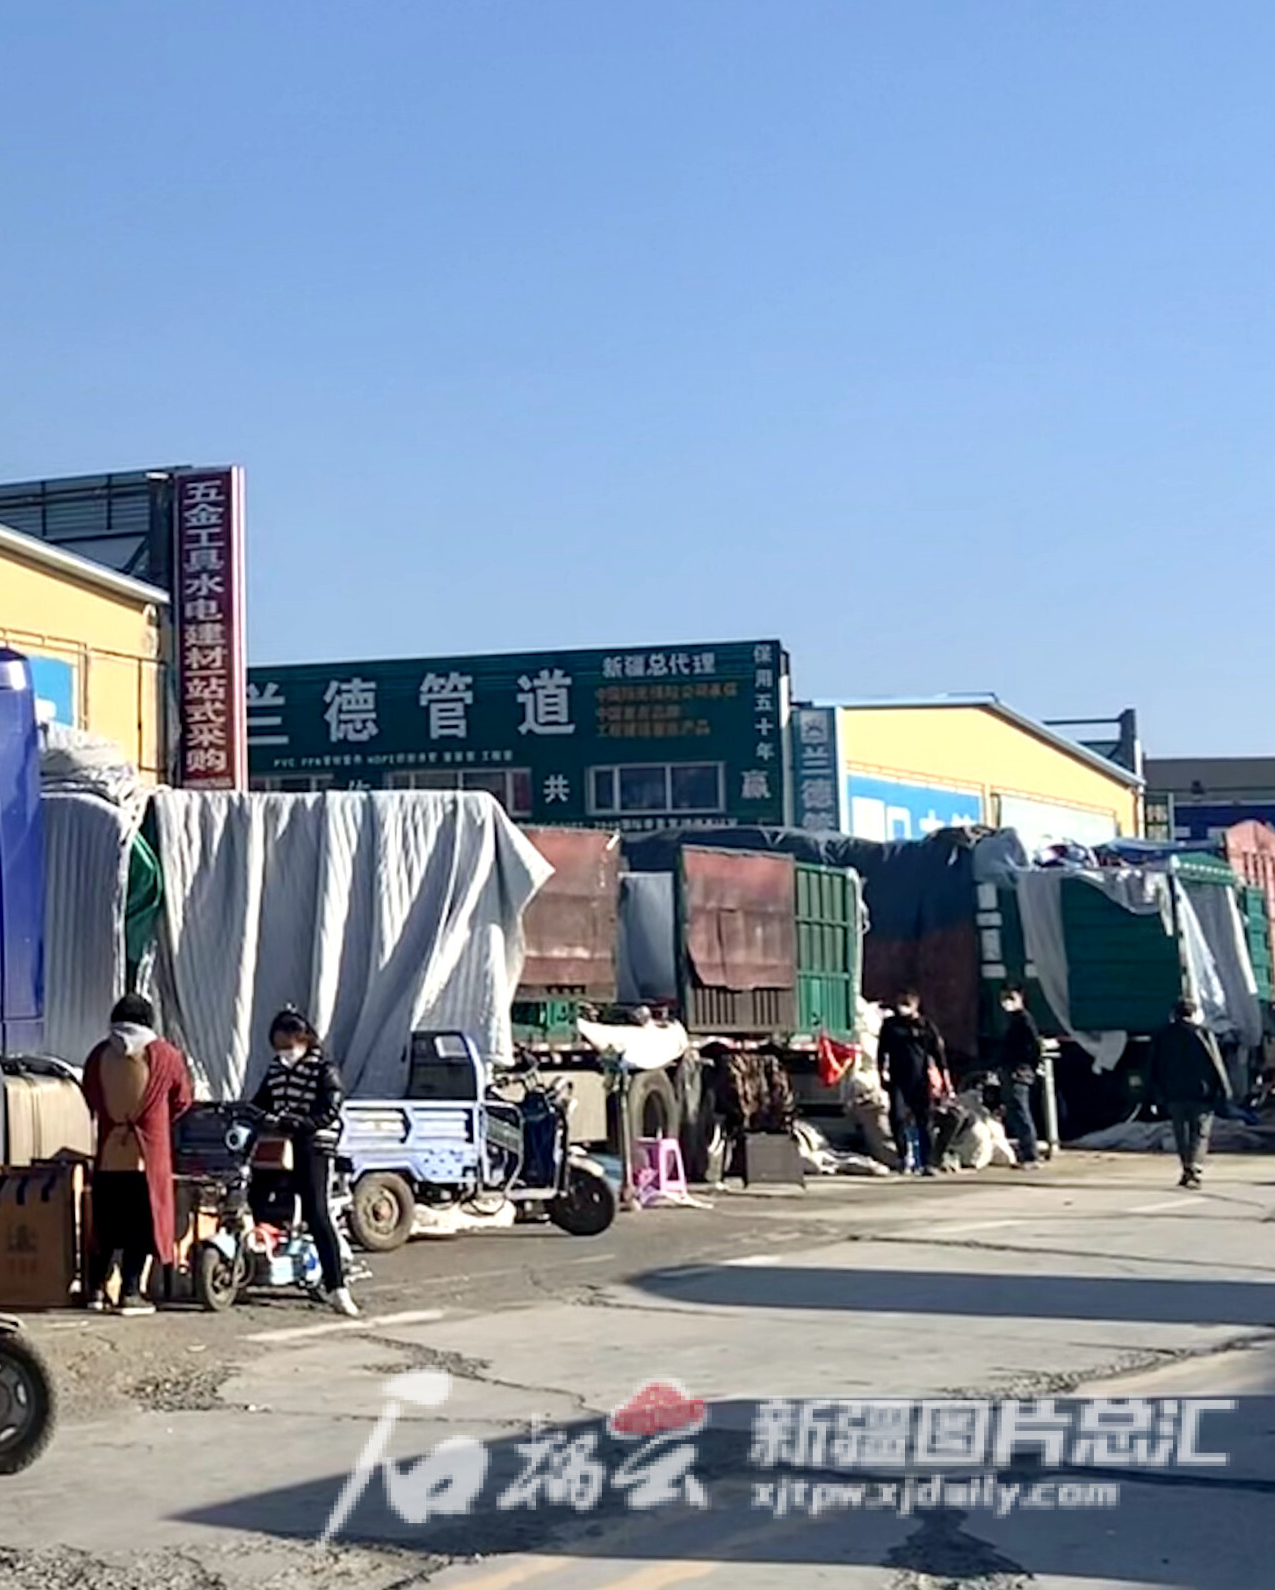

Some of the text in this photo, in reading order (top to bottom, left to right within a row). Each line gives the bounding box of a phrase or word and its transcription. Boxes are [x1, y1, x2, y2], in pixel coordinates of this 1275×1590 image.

[183, 480, 227, 772] 五金工具水电建材一站式采购
[602, 652, 716, 678] 新疆总代理
[753, 645, 774, 761] 保用五十年
[543, 774, 570, 803] 共
